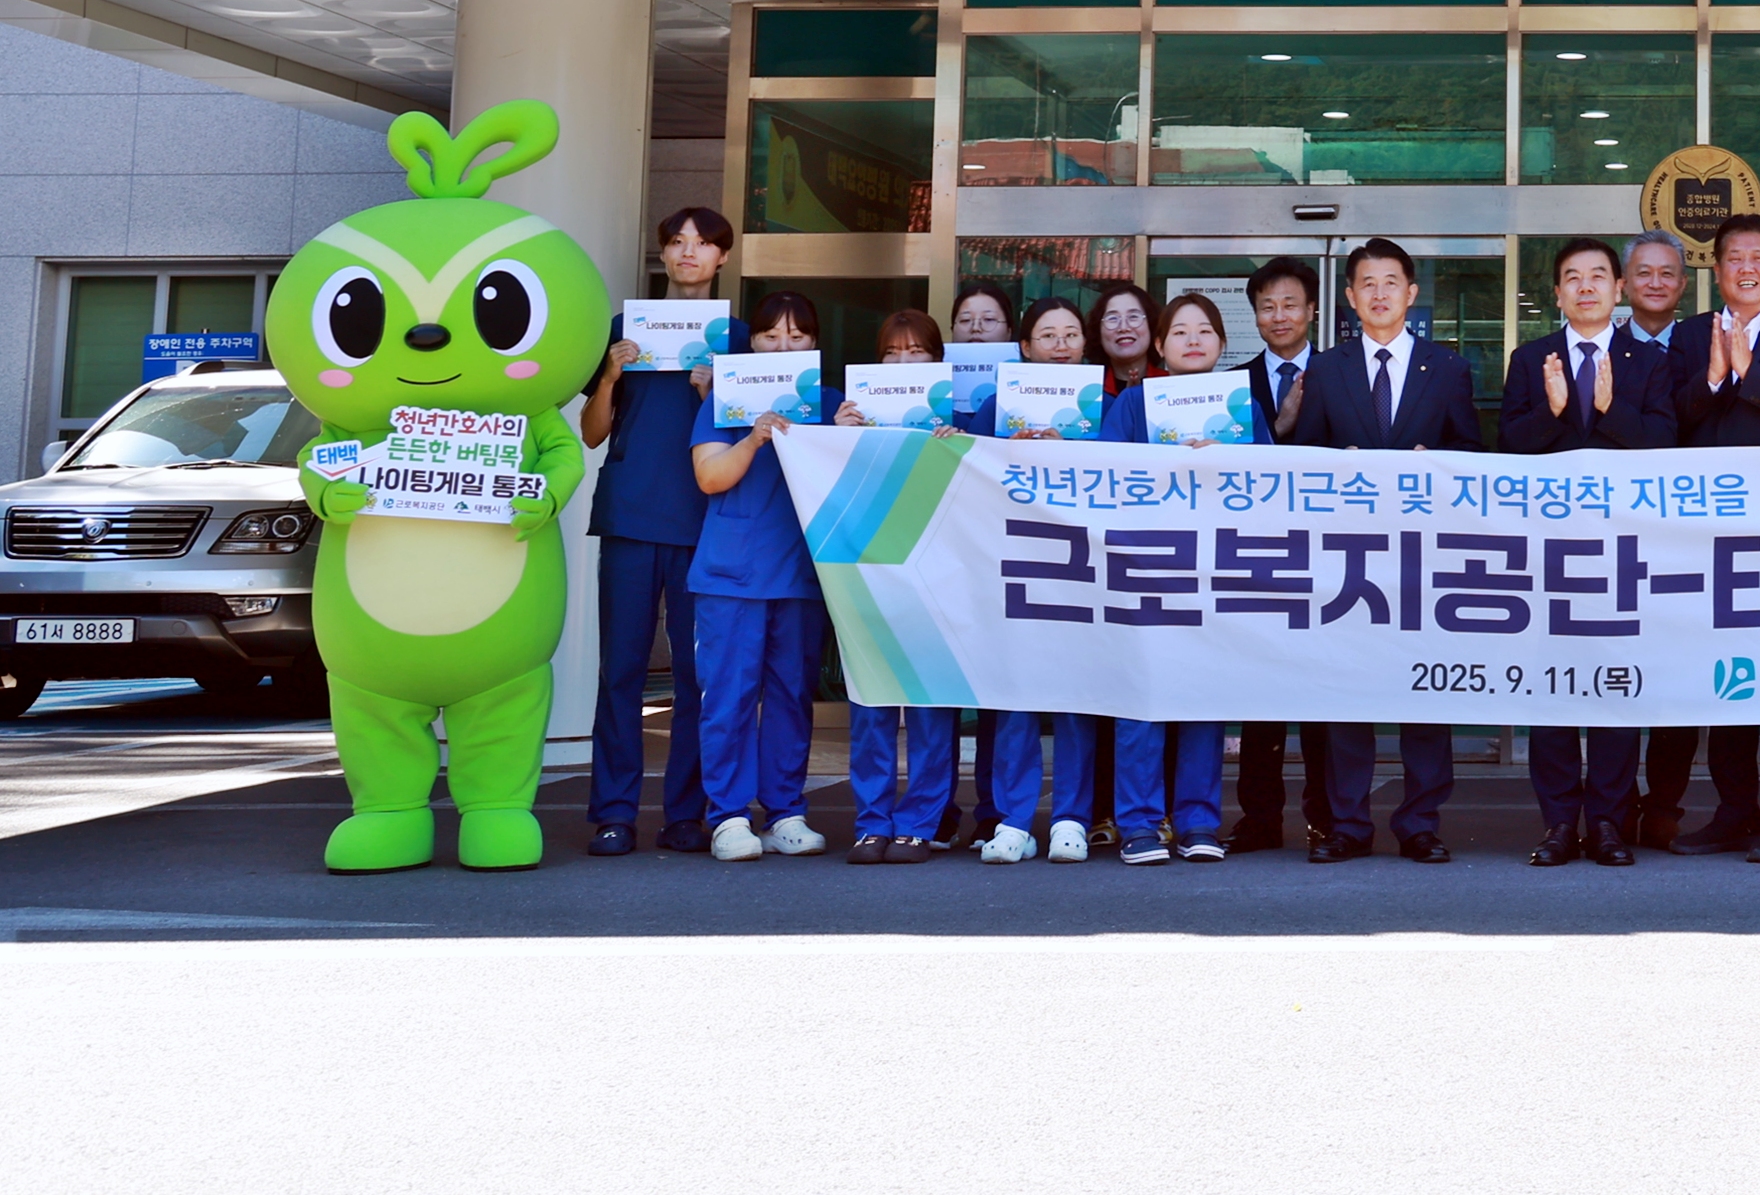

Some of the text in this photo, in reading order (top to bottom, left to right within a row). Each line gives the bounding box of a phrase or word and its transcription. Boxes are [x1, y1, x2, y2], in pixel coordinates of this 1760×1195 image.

[1686, 194, 1720, 204] 종합병원
[1737, 172, 1756, 208] PATIENT
[1678, 207, 1728, 217] 인증의료기관
[149, 337, 253, 350] 장애인 전용 주차구역
[978, 364, 993, 372] 통장
[395, 410, 523, 437] 청년간호사의
[316, 444, 358, 465] 태백
[387, 436, 519, 468] 든든한 버팀목
[359, 466, 543, 499] 나이팅게일 통장
[1000, 463, 1203, 512] 청년간호사
[1217, 470, 1382, 515] 장기근속
[1397, 472, 1436, 518] 및
[1451, 474, 1617, 521] 지역정착
[1630, 474, 1751, 520] 지원을
[395, 499, 501, 515] 근로복지공단 태백시
[26, 622, 123, 640] 61서 8888
[1412, 663, 1644, 699] 2025. 9. 11.(목)
